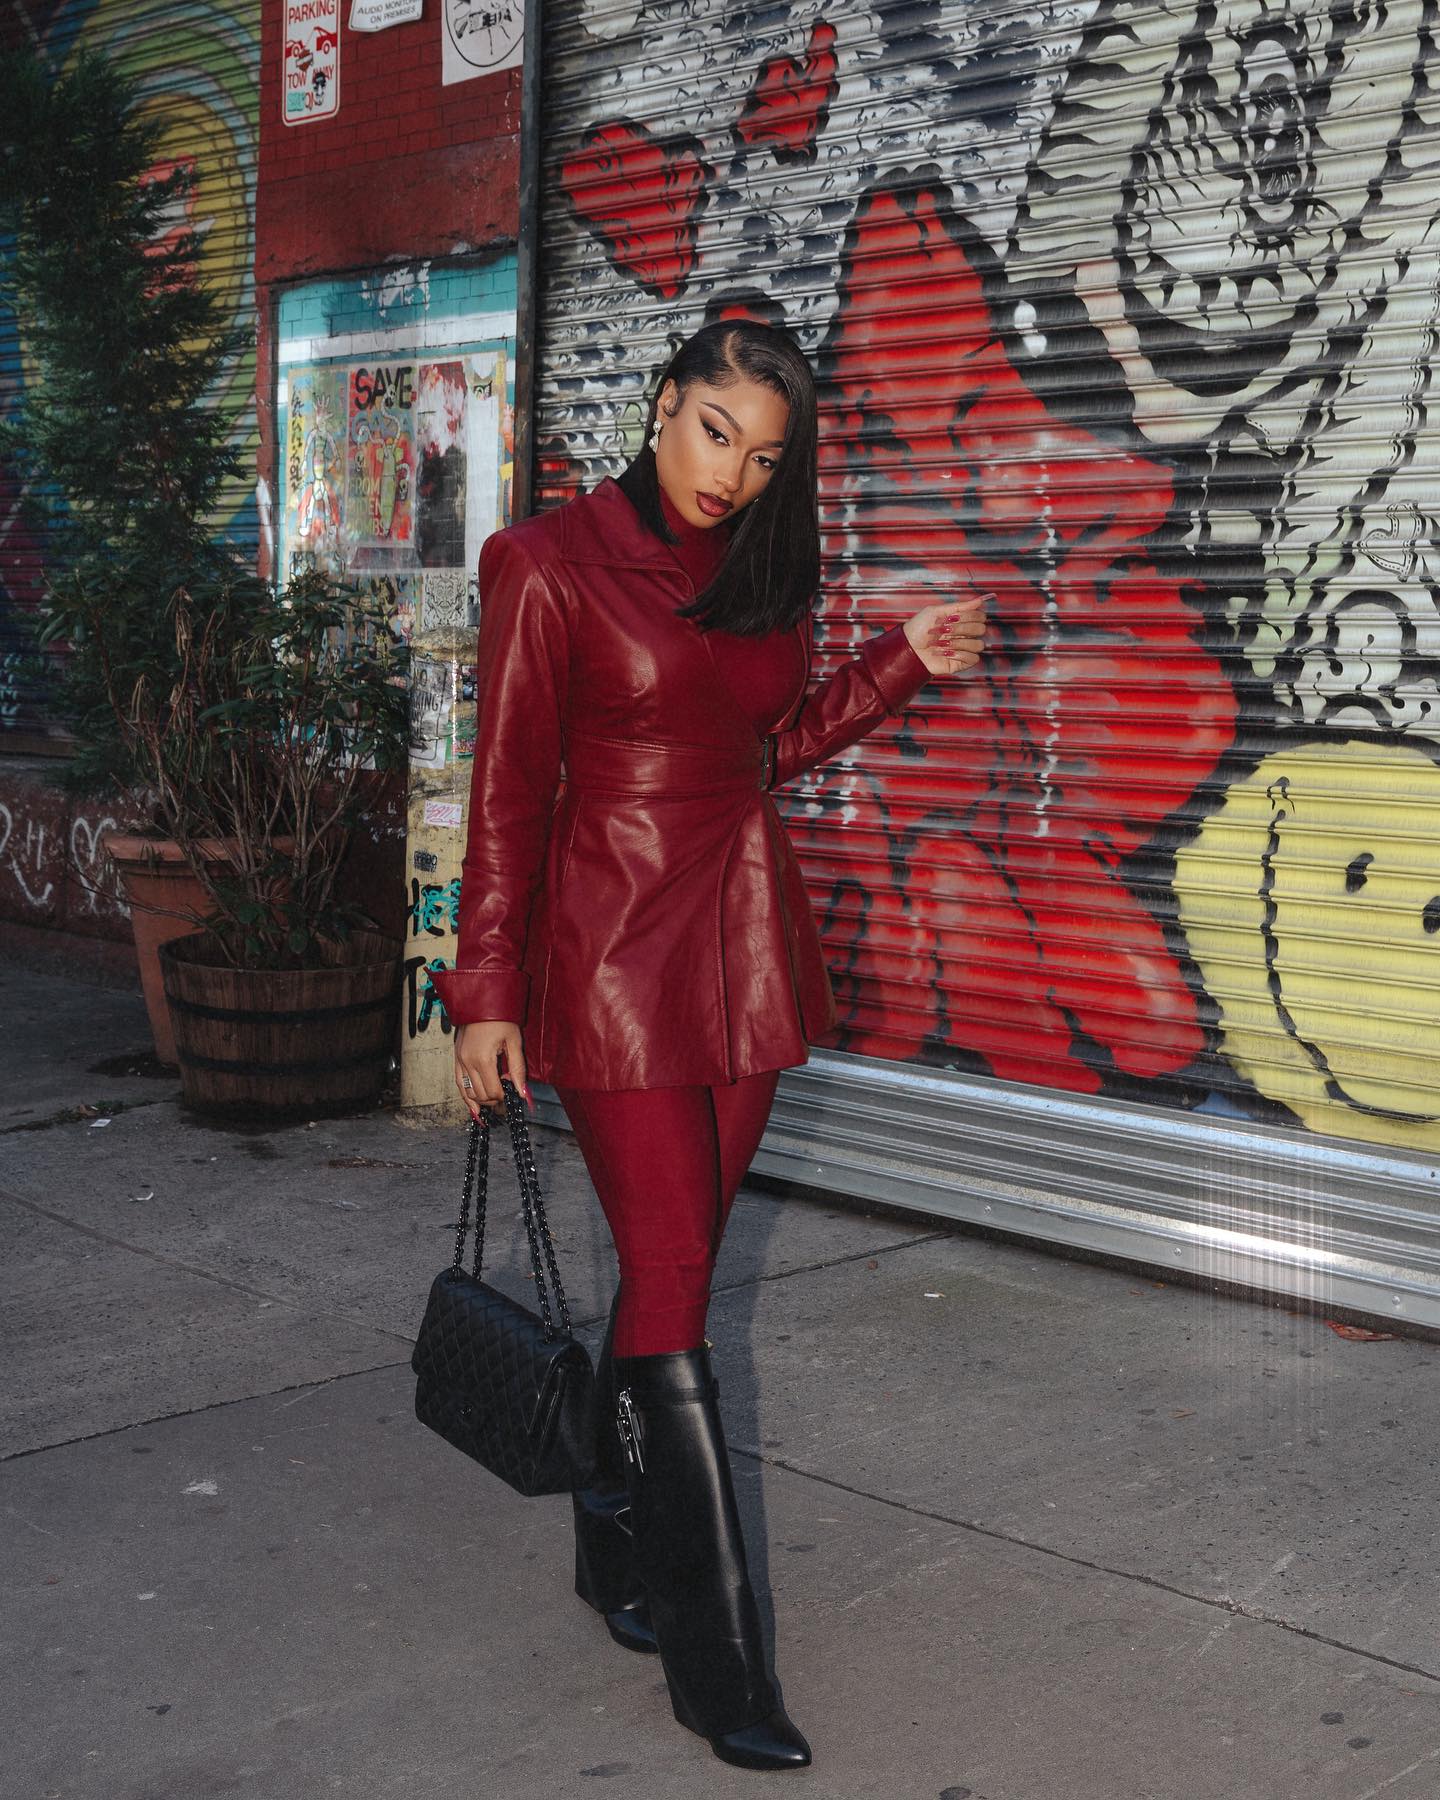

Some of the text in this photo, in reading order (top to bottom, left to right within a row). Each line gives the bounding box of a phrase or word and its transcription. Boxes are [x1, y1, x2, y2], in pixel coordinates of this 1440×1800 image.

[288, 0, 335, 24] PARKING
[357, 4, 383, 14] AUDIO
[370, 14, 382, 24] ON
[288, 71, 307, 89] TOW
[354, 366, 413, 410] SAVE
[351, 410, 415, 441] GAZA
[349, 477, 380, 496] FROM
